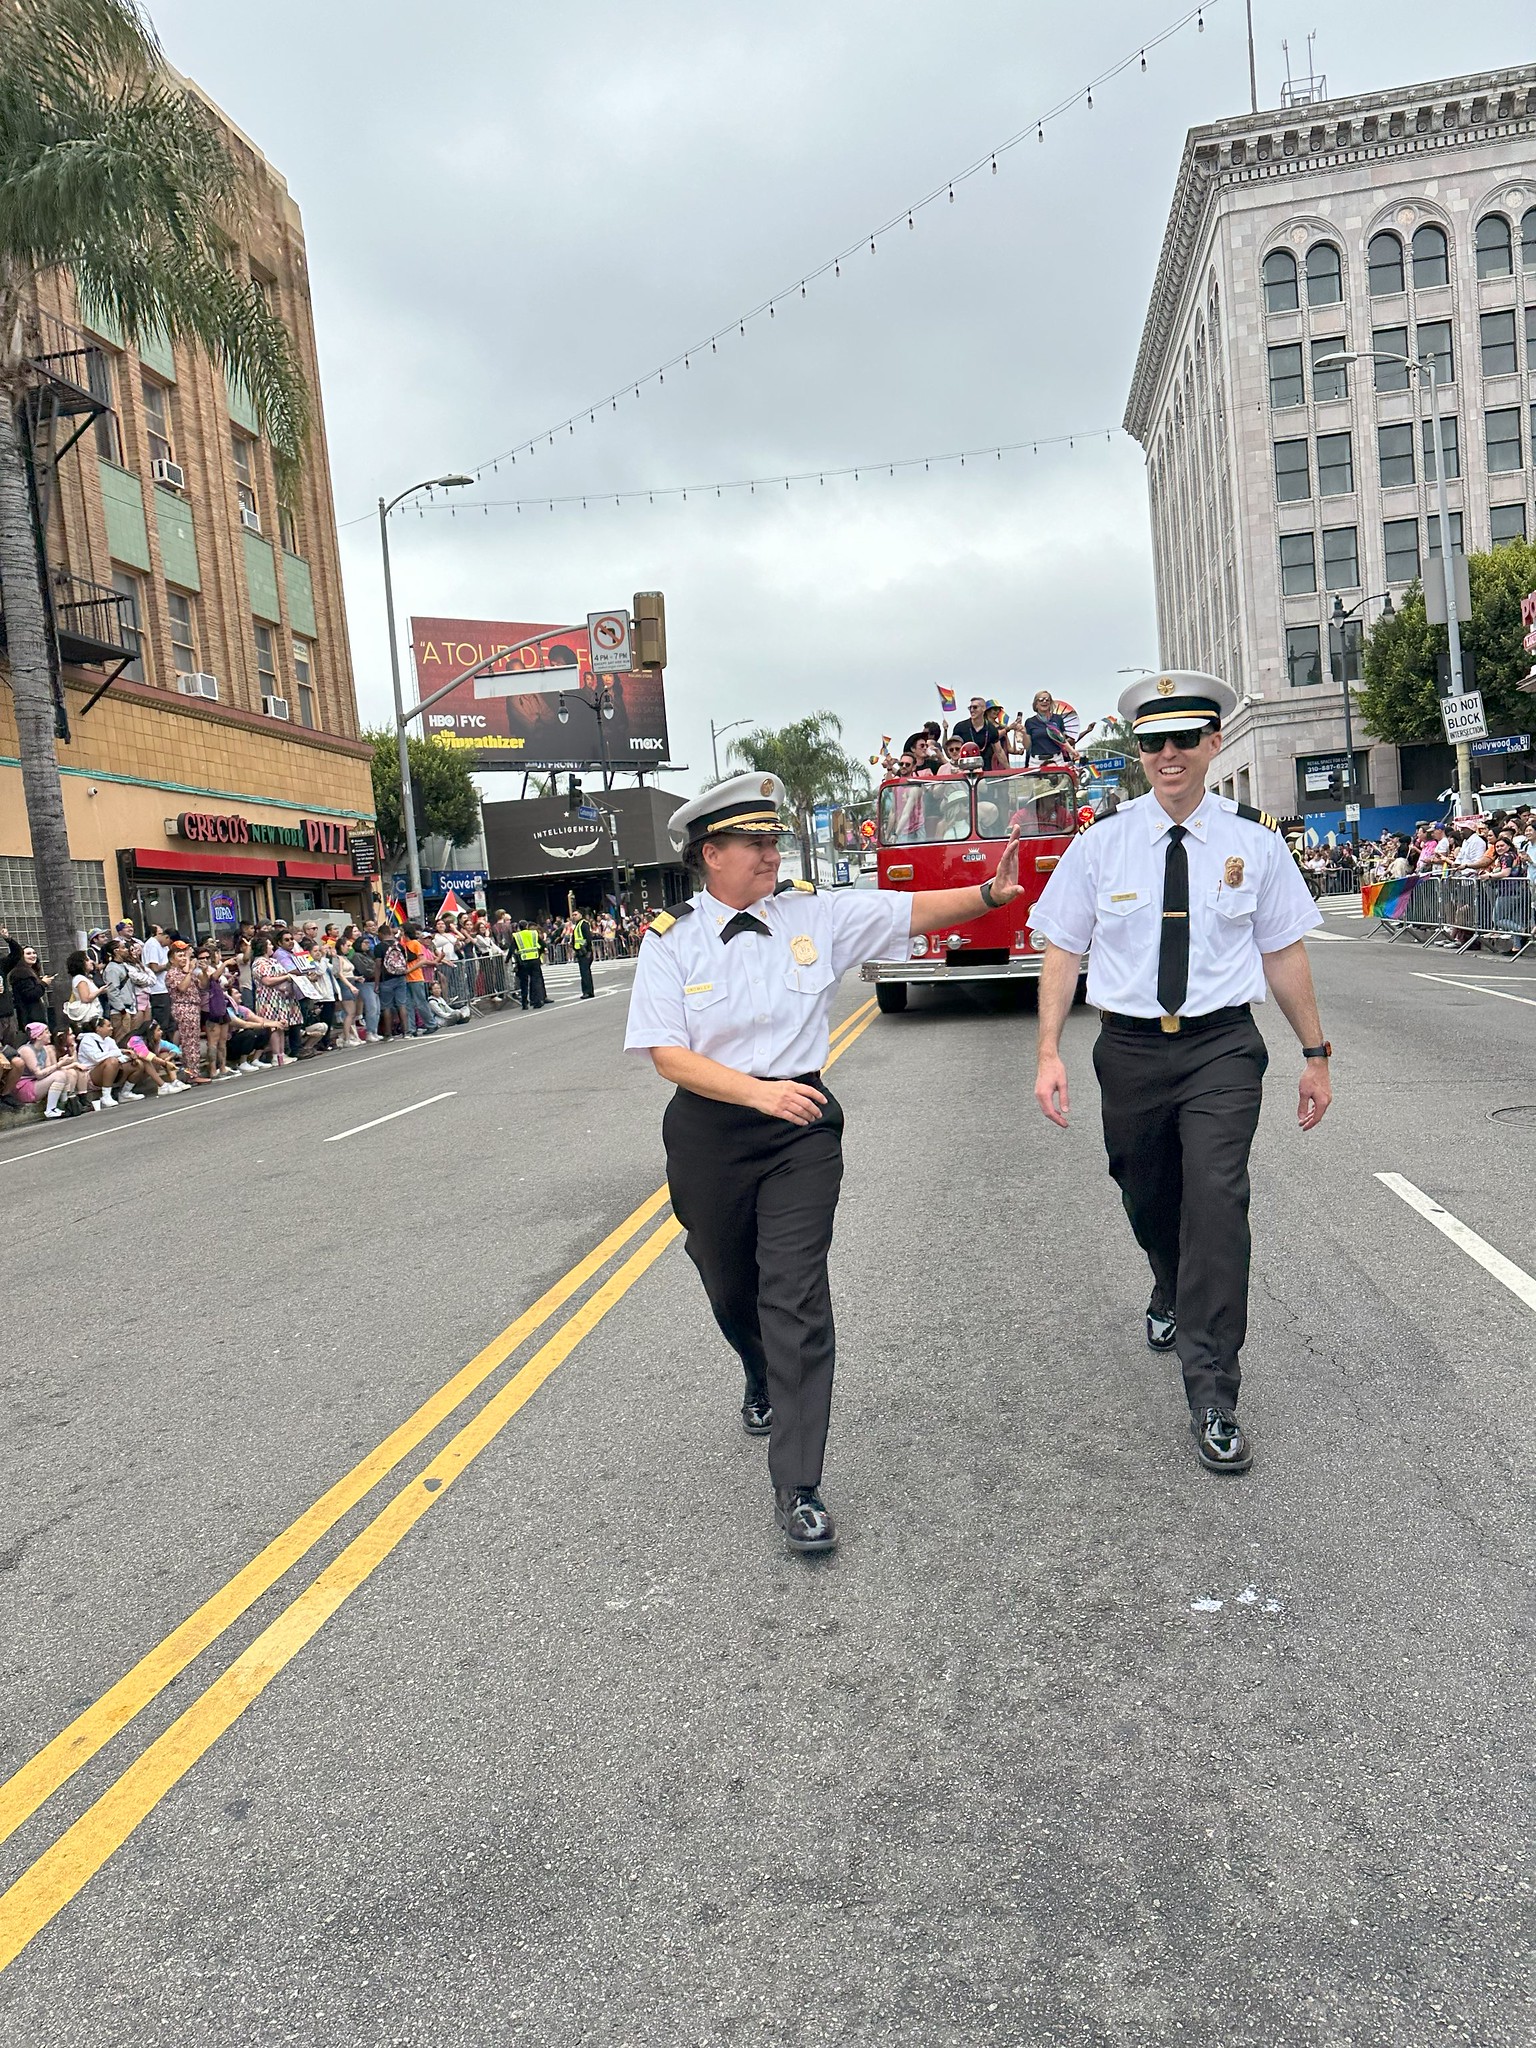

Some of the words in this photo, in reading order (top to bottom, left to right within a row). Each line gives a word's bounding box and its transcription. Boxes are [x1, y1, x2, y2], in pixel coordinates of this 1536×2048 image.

[614, 652, 619, 660] 7
[619, 652, 628, 660] PM
[1444, 702, 1458, 715] DO
[1460, 697, 1479, 711] NOT
[428, 714, 455, 728] HBO
[460, 715, 487, 728] FYC
[1447, 712, 1481, 729] BLOCK
[440, 729, 456, 738] the
[1449, 725, 1485, 739] INTERSECTION
[431, 735, 526, 750] Sympathizer
[629, 737, 664, 750] max
[1472, 738, 1511, 751] Hollywood
[1520, 736, 1528, 745] Bl
[184, 812, 249, 844] GRECO'S
[252, 824, 275, 844] NEW
[278, 827, 305, 848] YORK
[533, 825, 604, 839] INTELLIGENTSIA
